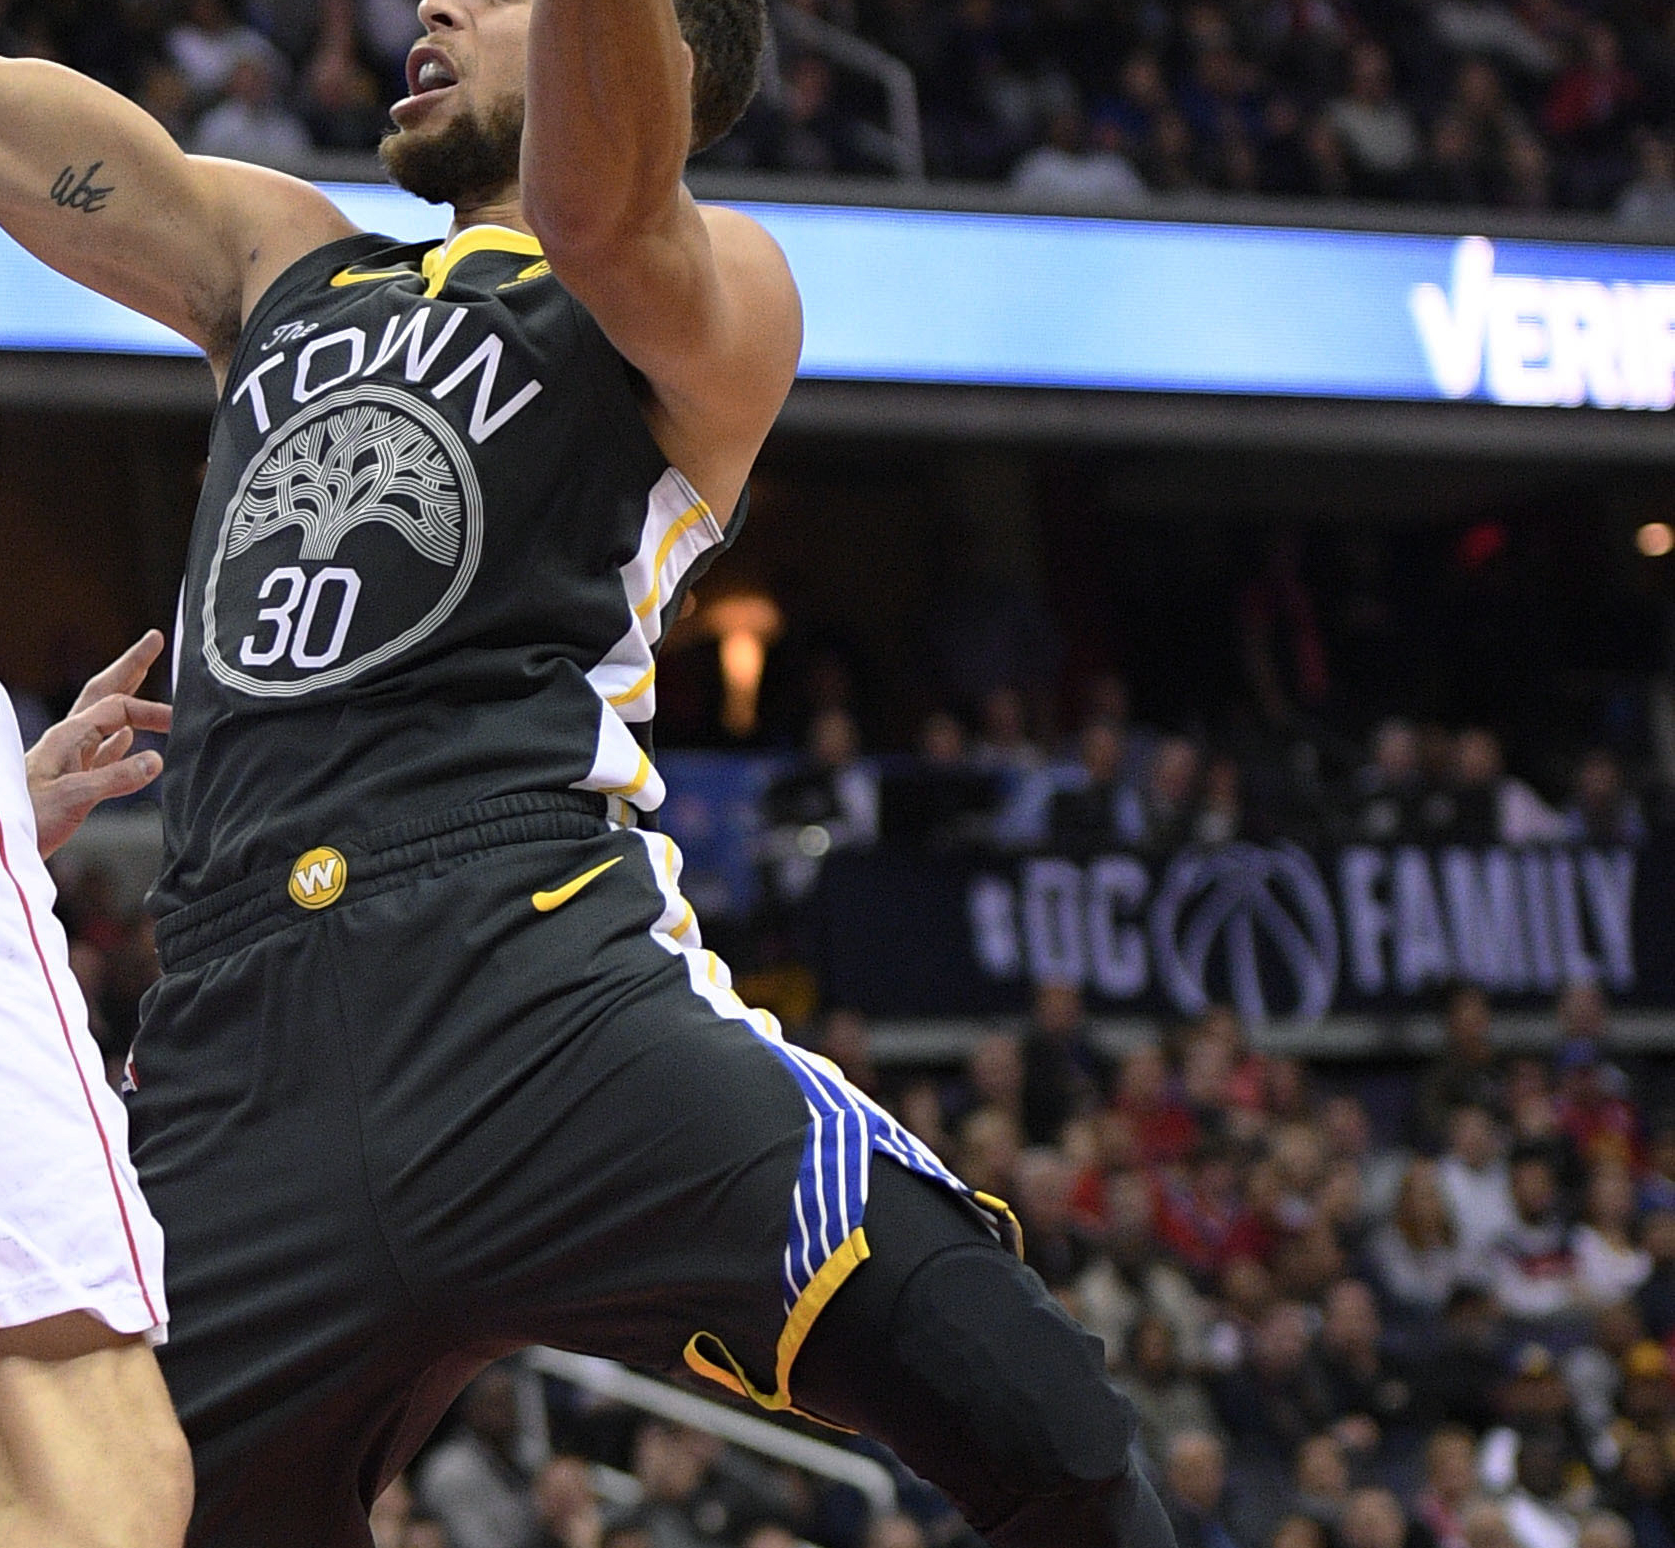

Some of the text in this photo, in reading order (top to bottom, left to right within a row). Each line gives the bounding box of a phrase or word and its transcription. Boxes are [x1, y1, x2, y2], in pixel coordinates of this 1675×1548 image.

[232, 306, 543, 445] TOWN
[261, 319, 320, 350] The
[239, 566, 362, 668] 30
[1338, 846, 1637, 996] FAMILY
